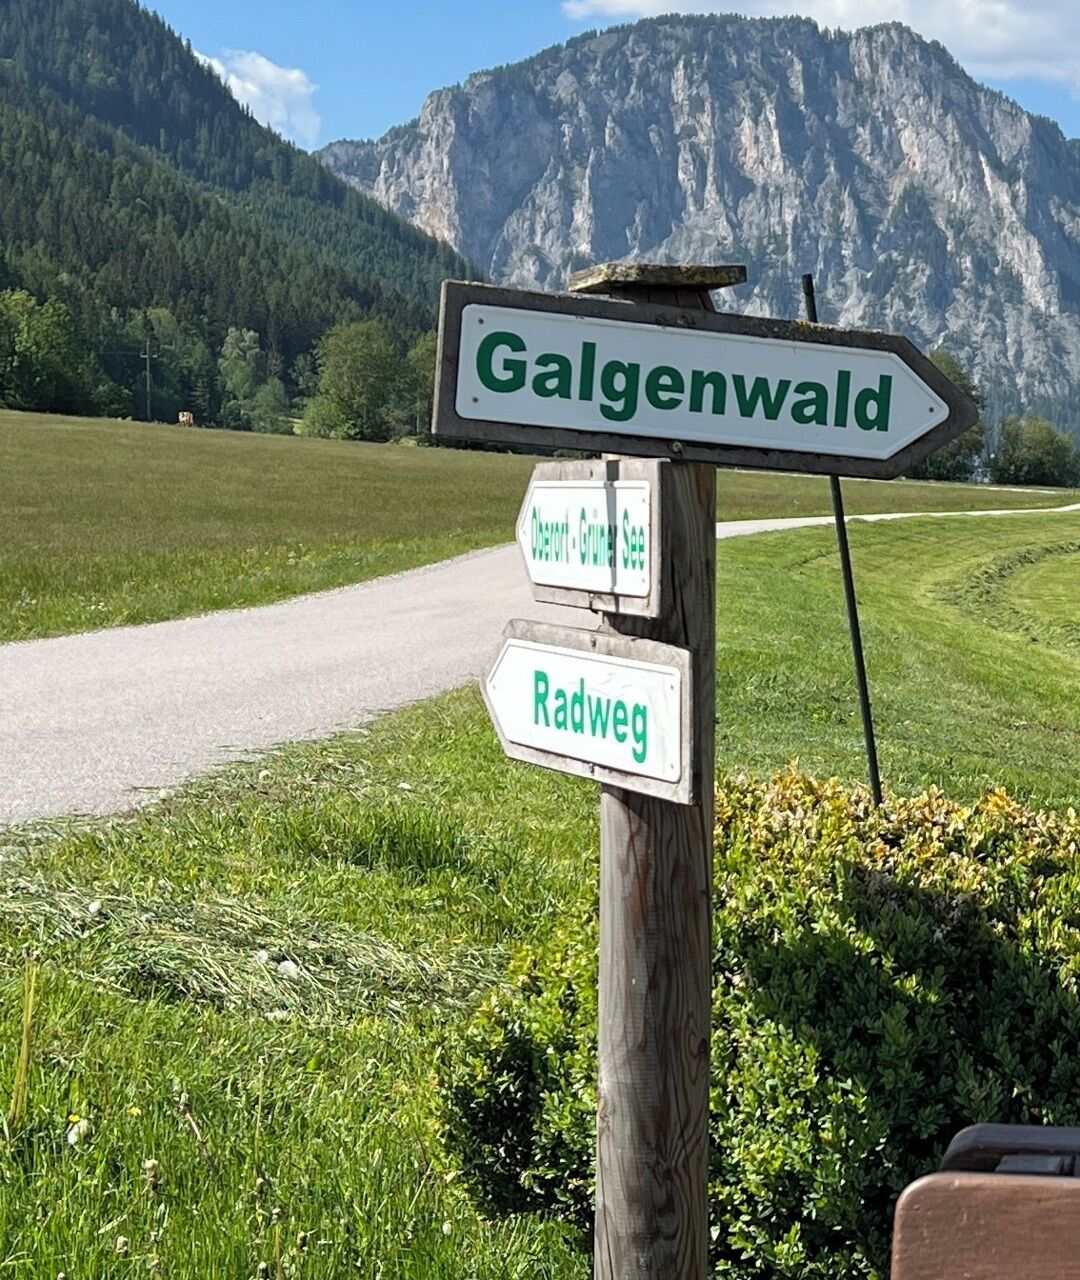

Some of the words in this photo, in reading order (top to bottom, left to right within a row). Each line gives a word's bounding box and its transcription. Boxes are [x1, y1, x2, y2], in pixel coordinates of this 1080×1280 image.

[475, 331, 893, 432] Galgenwald
[531, 506, 569, 563] Oberort
[579, 506, 618, 568] Grüner
[622, 508, 645, 570] See
[532, 669, 649, 764] Radweg
